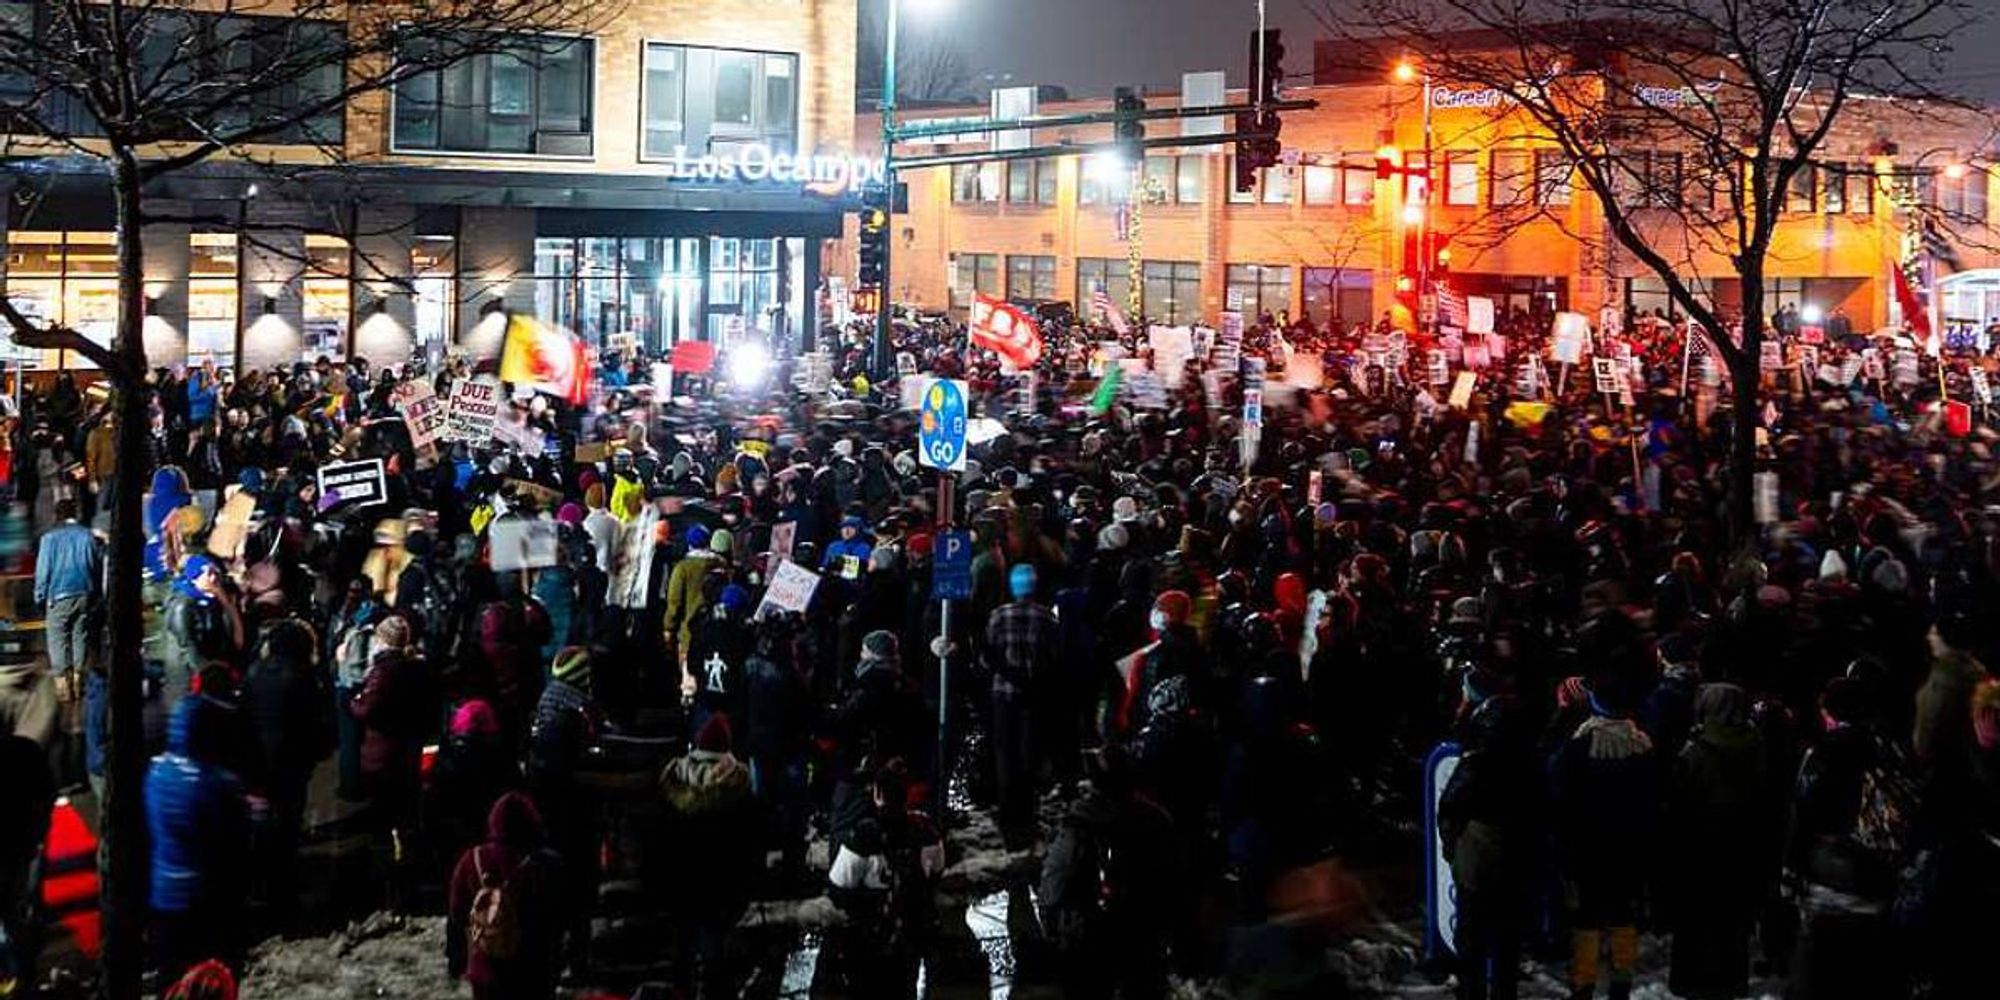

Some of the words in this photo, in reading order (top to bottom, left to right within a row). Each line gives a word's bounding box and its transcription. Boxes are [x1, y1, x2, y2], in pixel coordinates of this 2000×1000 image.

[674, 145, 733, 179] Los
[461, 382, 494, 401] DUE
[931, 440, 953, 463] GO
[947, 538, 960, 560] P
